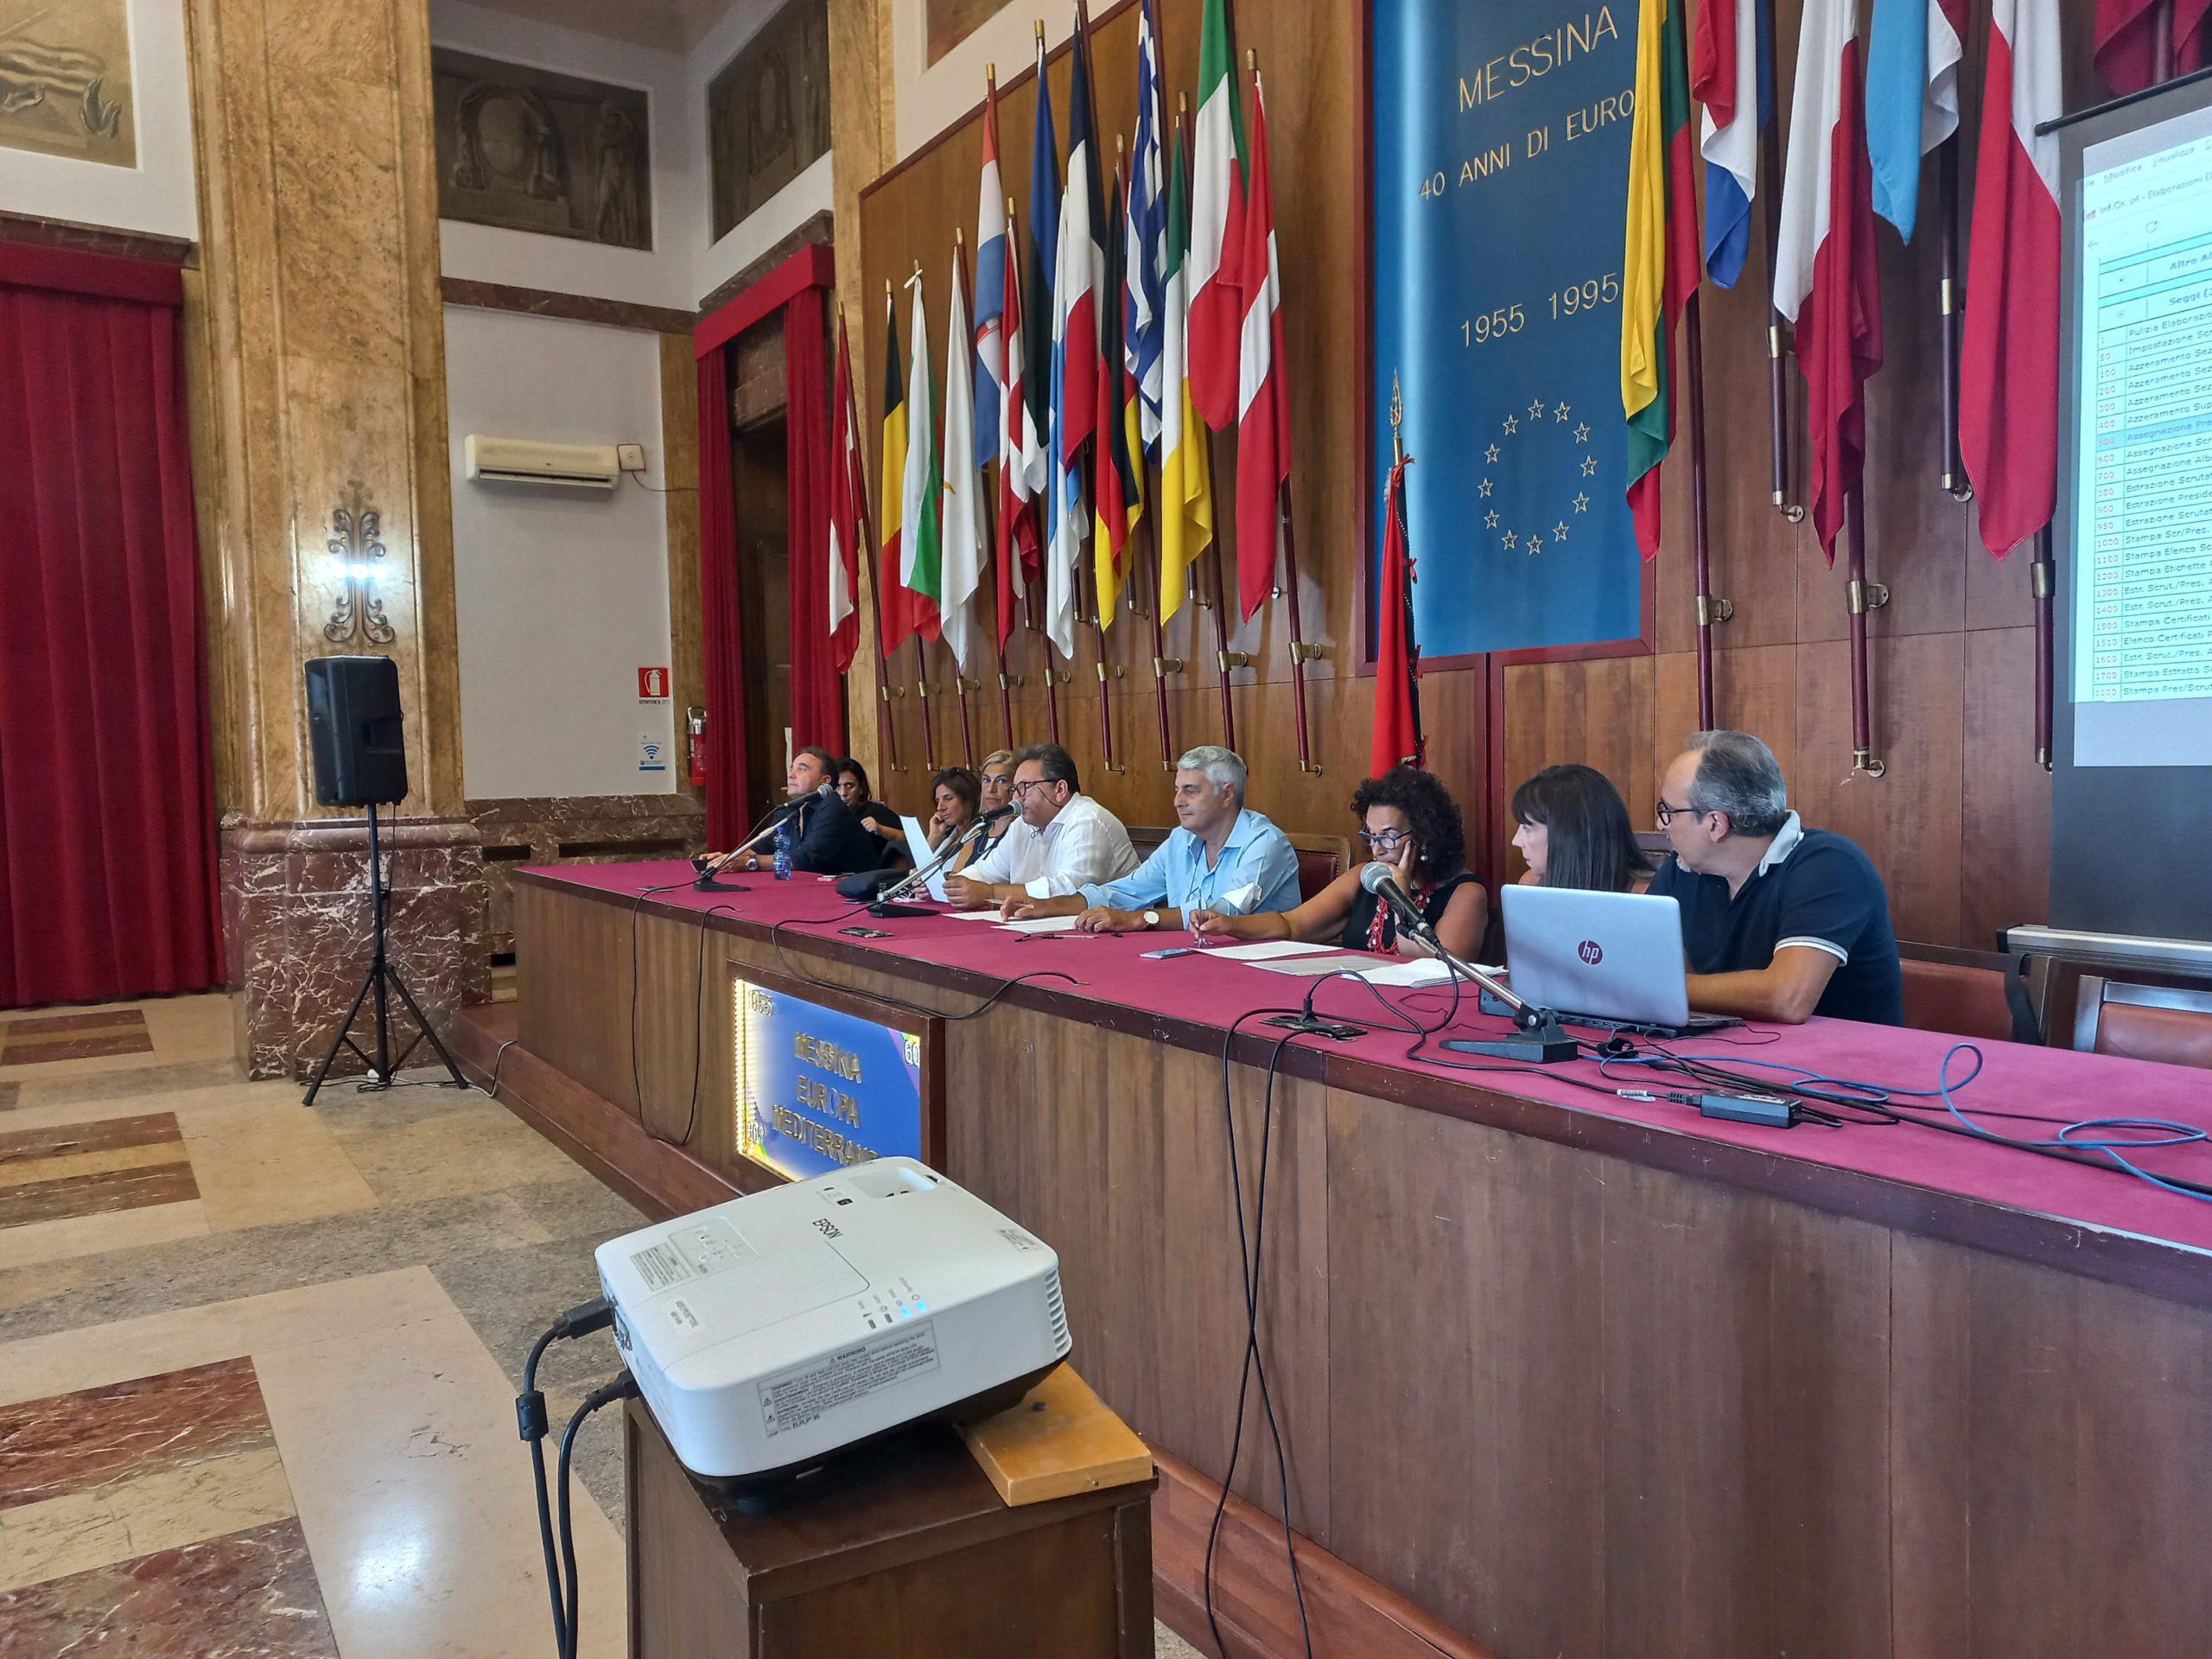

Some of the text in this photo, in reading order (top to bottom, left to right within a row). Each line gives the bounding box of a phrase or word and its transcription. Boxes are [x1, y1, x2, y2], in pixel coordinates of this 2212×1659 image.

[1459, 4, 1618, 113] MESSINA
[1419, 90, 1635, 200] 40 ANNI DI EURO
[1460, 272, 1620, 348] 1955 1995
[2128, 353, 2191, 372] Azzeramento
[2128, 370, 2190, 389] Azzeramento
[2127, 387, 2190, 406] Azzeramento
[2127, 406, 2190, 423] Azzeramento
[2126, 441, 2192, 458] Assegnazione
[2126, 458, 2191, 475] Assegnazione
[2126, 480, 2175, 493] Estrazione
[2126, 497, 2174, 510] Estrazione
[2126, 514, 2174, 527] Estrazione
[2125, 532, 2161, 543] Stampa
[2125, 550, 2161, 561] Stampa
[2164, 545, 2196, 556] Elenco
[2125, 567, 2161, 578] Stampa
[2124, 619, 2160, 629] Stampa
[2124, 636, 2154, 645] Elenco
[2123, 670, 2159, 679] Stampa
[794, 1031, 862, 1084] MESSINA
[797, 1074, 861, 1129] EUROPA
[812, 1217, 843, 1239] EPSON
